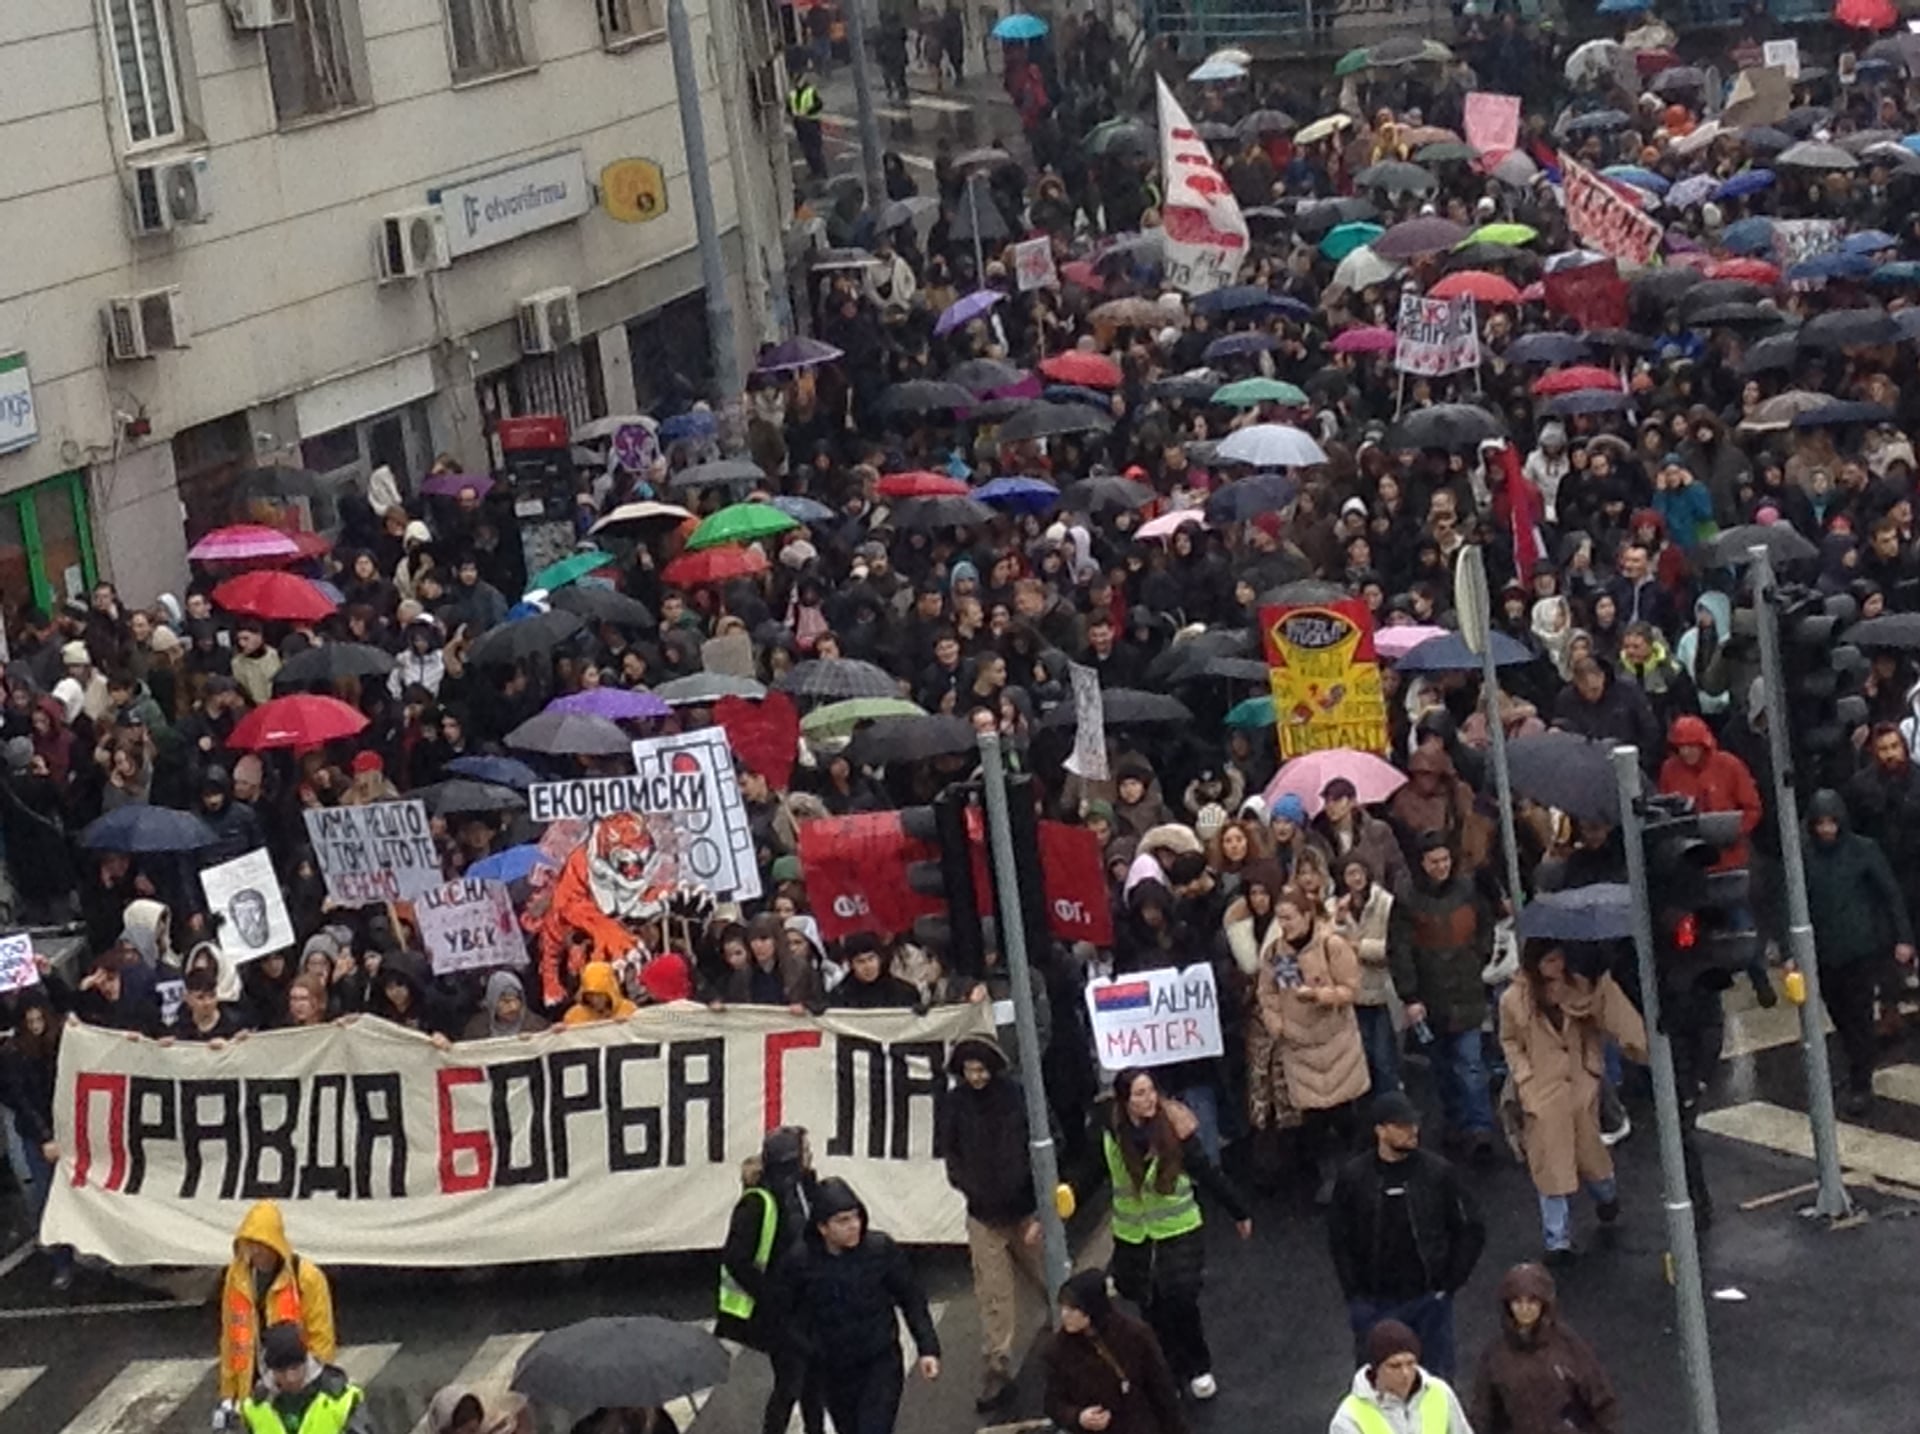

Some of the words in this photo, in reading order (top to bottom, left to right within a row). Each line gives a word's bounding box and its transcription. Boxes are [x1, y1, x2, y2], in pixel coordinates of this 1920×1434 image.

[534, 774, 708, 820] ЕКОНОМСКИ
[316, 811, 360, 842] ИМА
[1153, 979, 1216, 1016] ALMA
[1106, 1017, 1205, 1058] MATER
[71, 1072, 407, 1199] ПРАВДА
[436, 1036, 726, 1194] БОРБА
[764, 1031, 950, 1161] ГЛА
